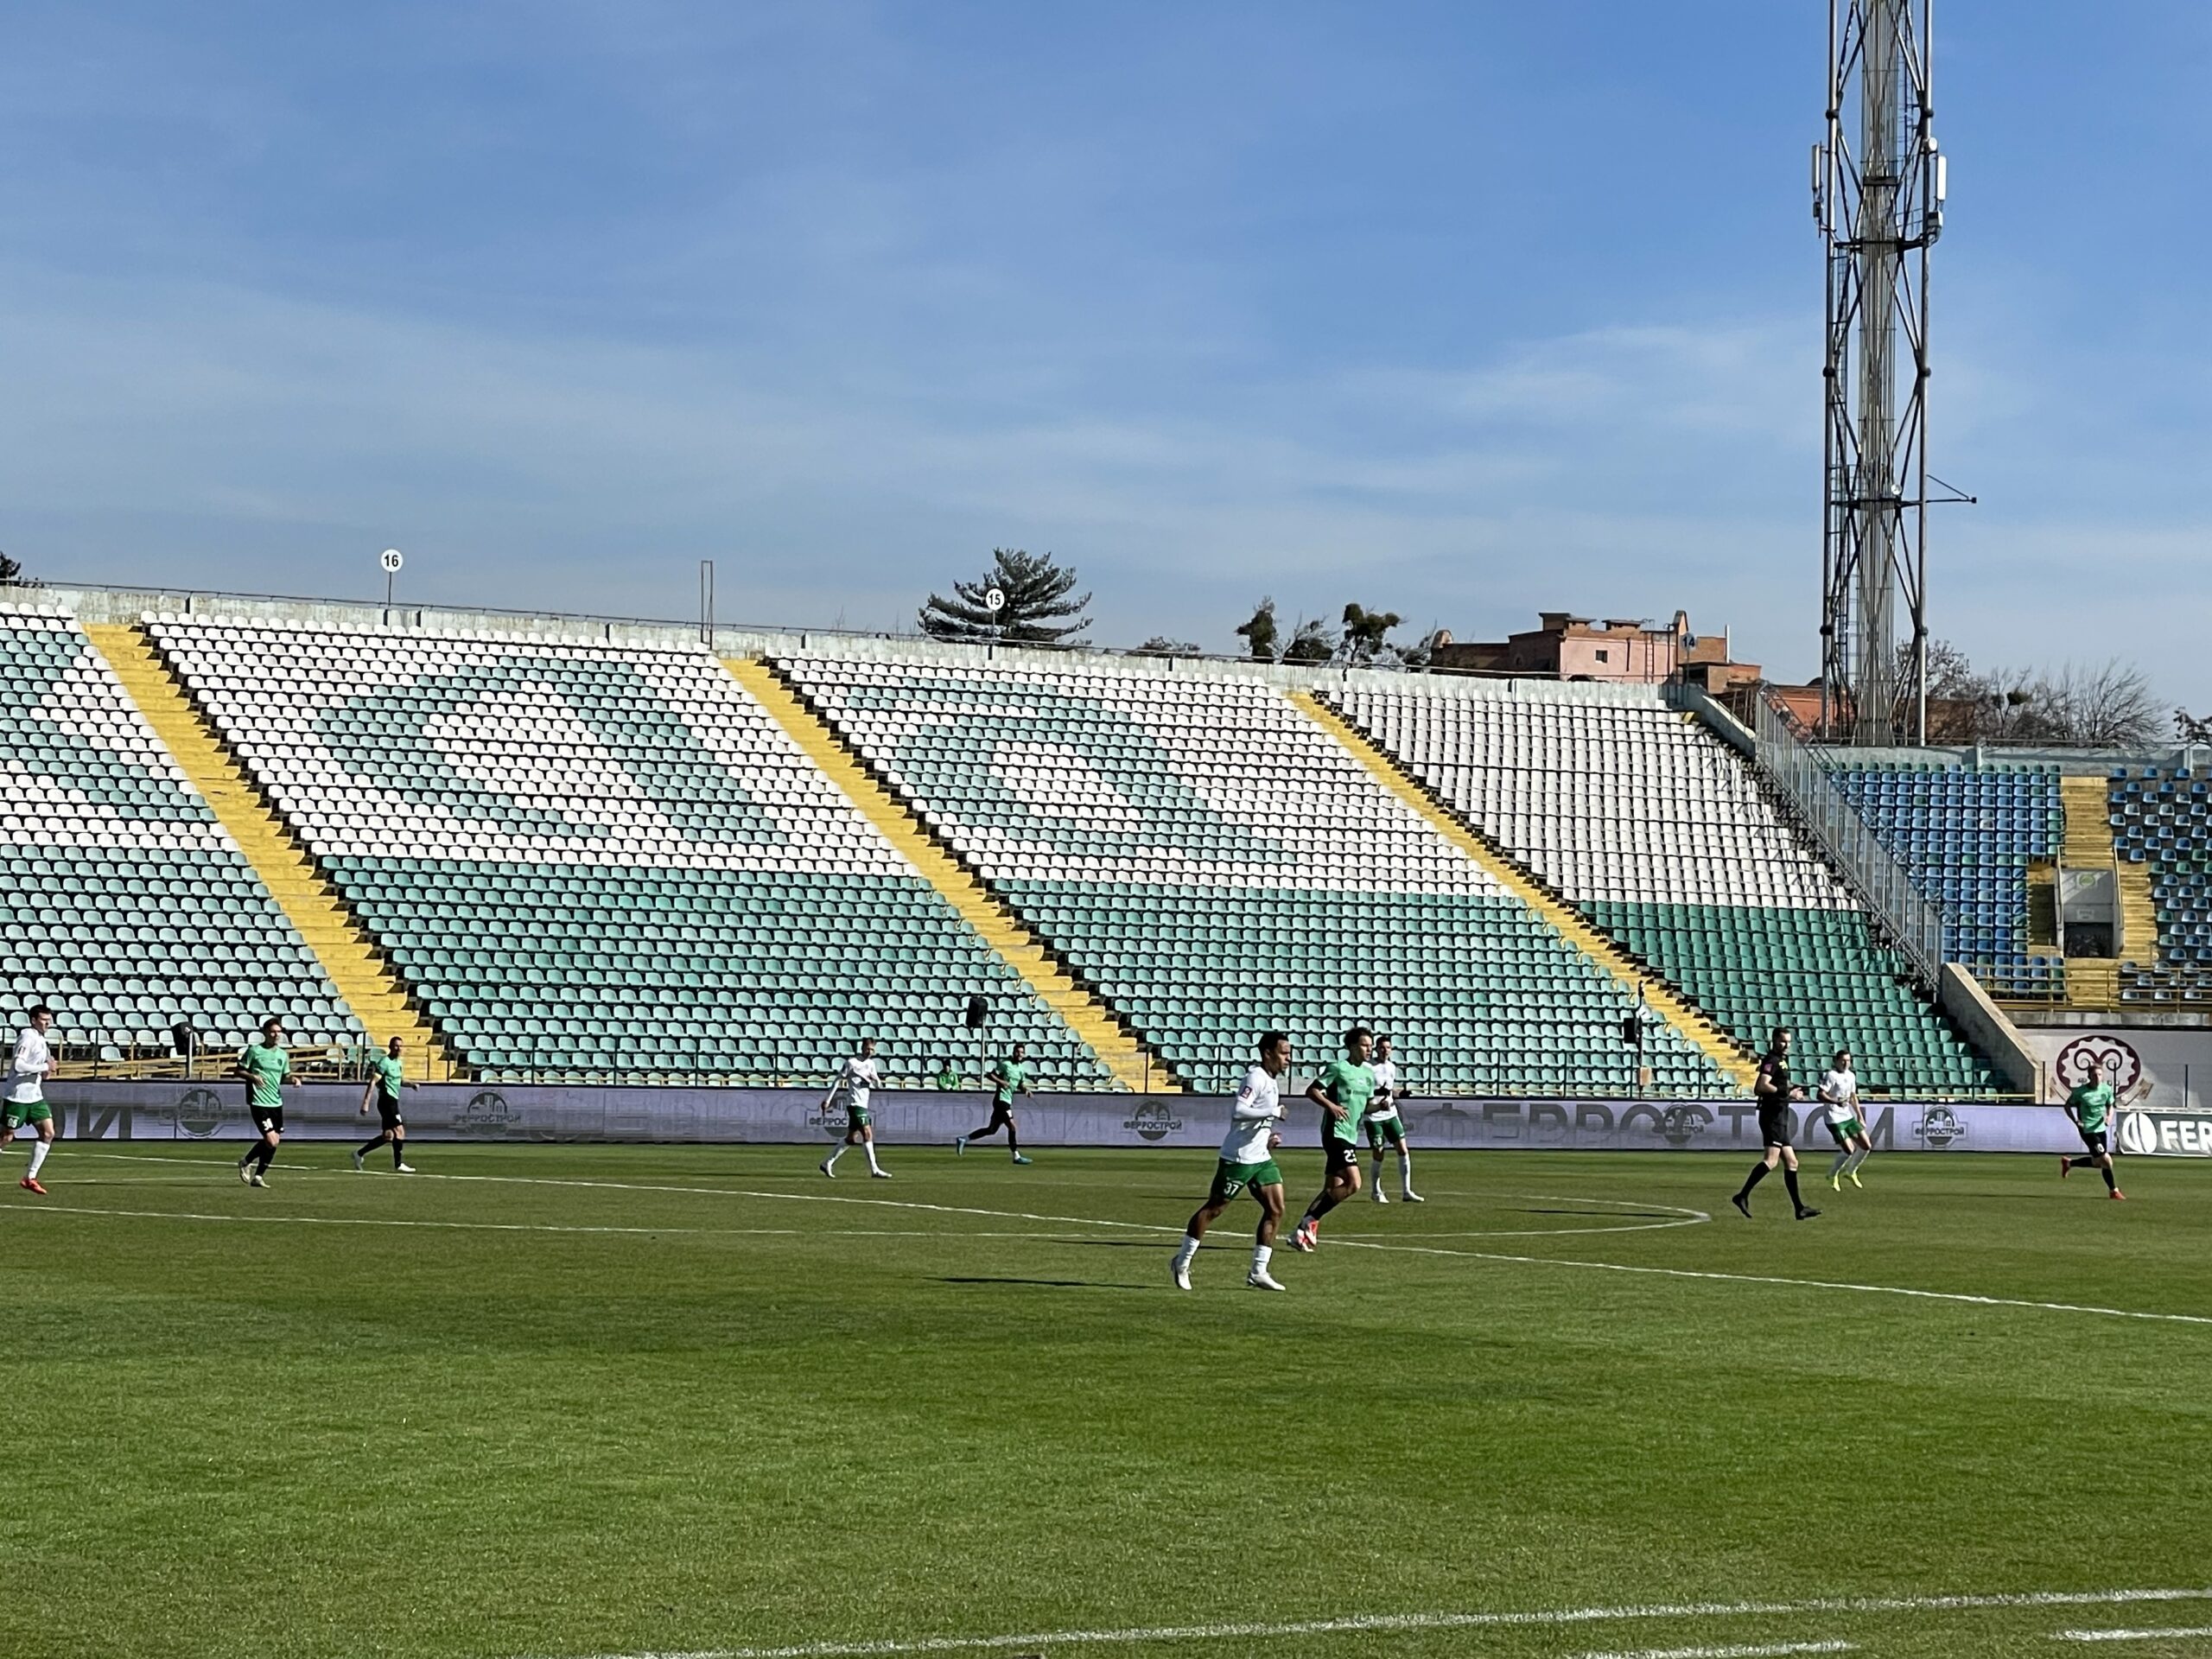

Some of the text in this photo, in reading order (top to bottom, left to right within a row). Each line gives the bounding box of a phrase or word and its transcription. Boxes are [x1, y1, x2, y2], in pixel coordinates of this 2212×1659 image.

[384, 554, 399, 567] 16
[988, 594, 1001, 605] 15
[1683, 636, 1695, 647] 14
[1224, 1181, 1240, 1196] 37
